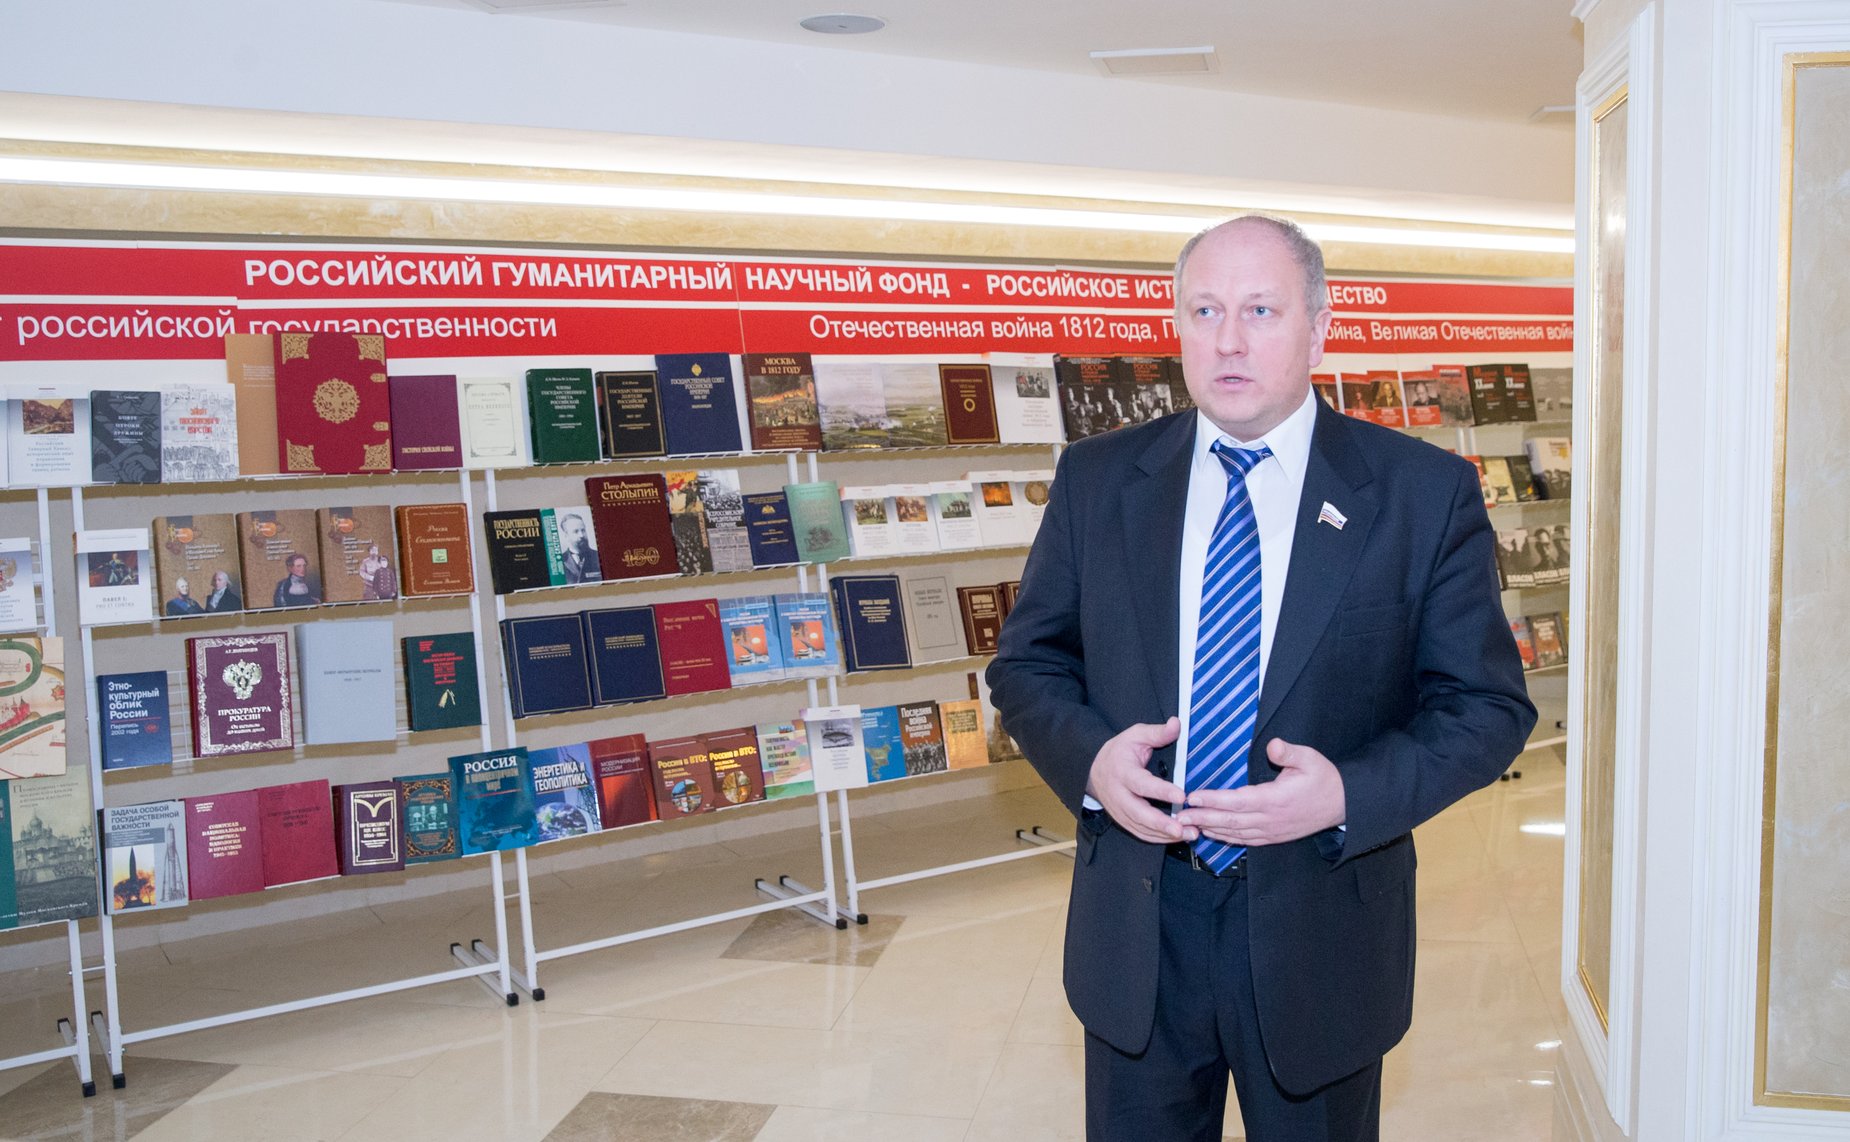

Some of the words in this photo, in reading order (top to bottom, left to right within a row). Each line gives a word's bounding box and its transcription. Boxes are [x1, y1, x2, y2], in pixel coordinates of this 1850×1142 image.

[244, 254, 484, 286] РОССИЙСКИЙ
[492, 262, 732, 290] ГУМАНИТАРНЫЙ
[745, 265, 872, 293] НАУЧНЫЙ
[879, 272, 950, 299] ФОНД
[986, 272, 1130, 299] РОССИЙСКОЕ
[1325, 285, 1387, 306] ЕСТВО
[17, 309, 235, 346] российской
[809, 315, 985, 339] Отечественная
[991, 315, 1054, 338] война
[1059, 317, 1106, 338] 1812
[1109, 322, 1157, 343] года,
[1370, 321, 1438, 340] Великая
[1440, 321, 1544, 340] Отечественная
[764, 357, 796, 366] МОСКВА
[761, 366, 767, 374] В
[783, 365, 801, 375] ГОДУ
[601, 487, 659, 500] СТОЛЫПИН
[496, 527, 540, 539] РОССИИ
[108, 682, 132, 691] Этно-
[109, 688, 159, 701] культурный
[109, 700, 142, 710] облик
[218, 706, 271, 716] ПРОКУРАТУРА
[110, 710, 148, 720] России
[229, 714, 260, 722] РОССИИ
[464, 755, 518, 773] РОССИЯ
[533, 761, 579, 779] ЭНЕРГЕТИКА
[535, 773, 588, 792] ГЕОПОЛИТИКА
[111, 809, 138, 817] ЗАДАЧА
[140, 804, 169, 813] ОСОБОЙ
[111, 811, 179, 823] ГОСУДАРСТВЕННОЙ
[111, 822, 150, 831] ВАЖНОСТИ
